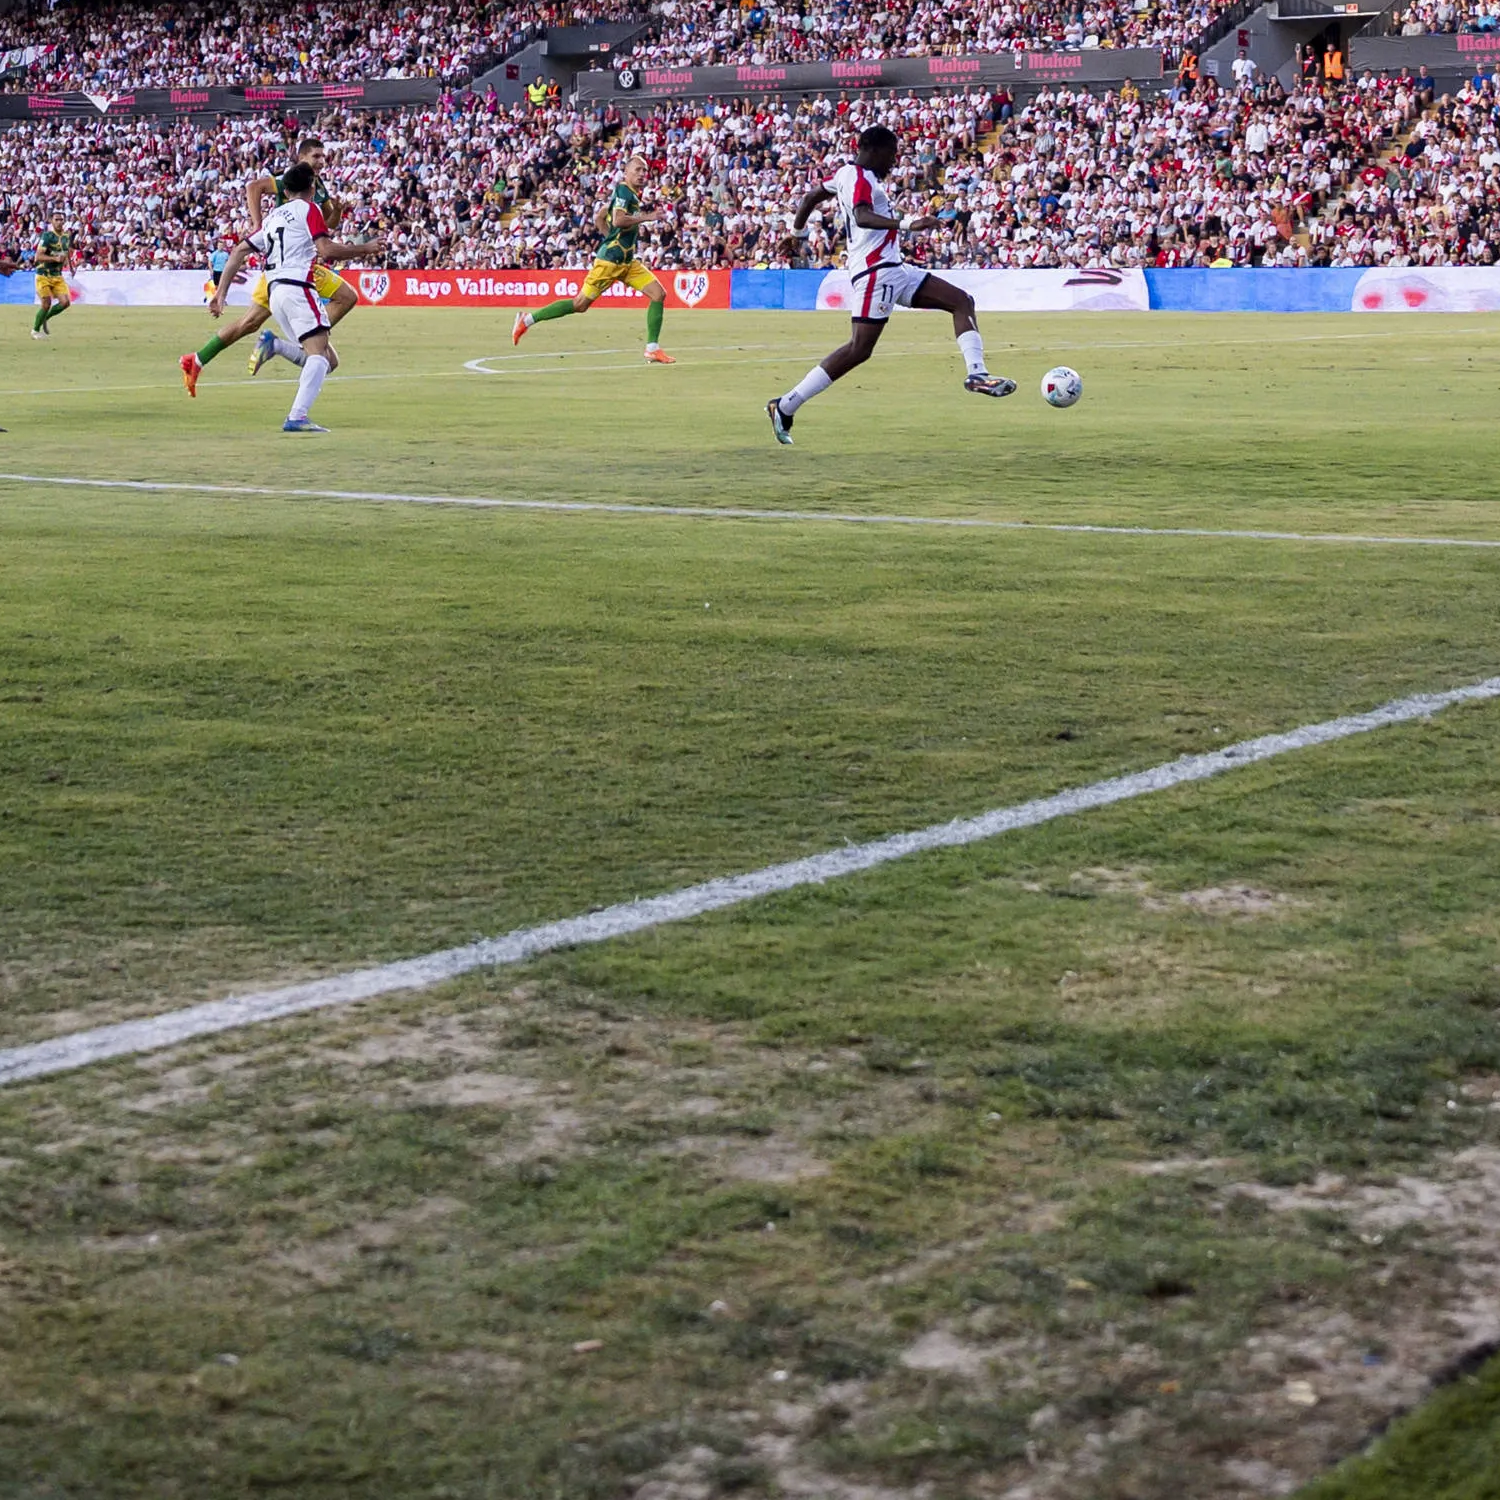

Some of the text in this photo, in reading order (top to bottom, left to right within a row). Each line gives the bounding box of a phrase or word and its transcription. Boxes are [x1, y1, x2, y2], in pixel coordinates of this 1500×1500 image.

[929, 57, 980, 74] Mahou
[1029, 52, 1081, 69] Mahou
[646, 69, 693, 84] Mahou
[737, 66, 786, 81] Mahou
[832, 62, 882, 78] Mahou
[170, 89, 209, 103] Mahou
[405, 278, 452, 299] Rayo
[456, 276, 549, 296] Vallecano
[554, 277, 578, 296] de
[882, 284, 894, 303] 11
